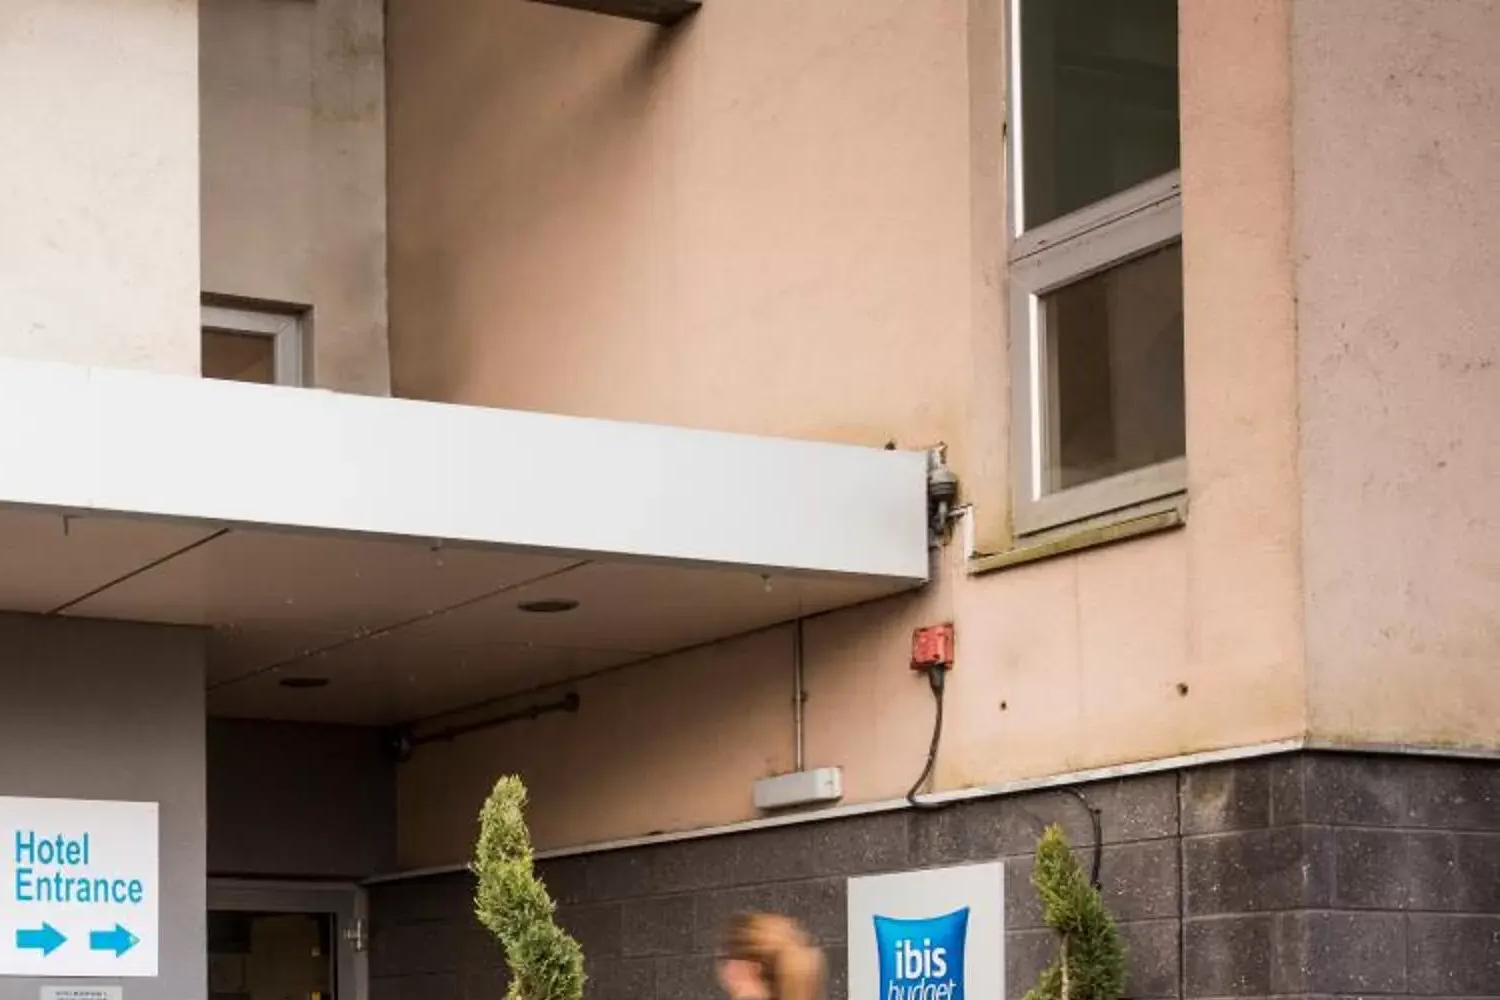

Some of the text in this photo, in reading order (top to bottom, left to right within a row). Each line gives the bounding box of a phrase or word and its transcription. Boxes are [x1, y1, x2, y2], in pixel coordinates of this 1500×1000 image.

[14, 830, 90, 866] Hotel
[14, 868, 144, 904] Entrance
[895, 938, 948, 980] ibis
